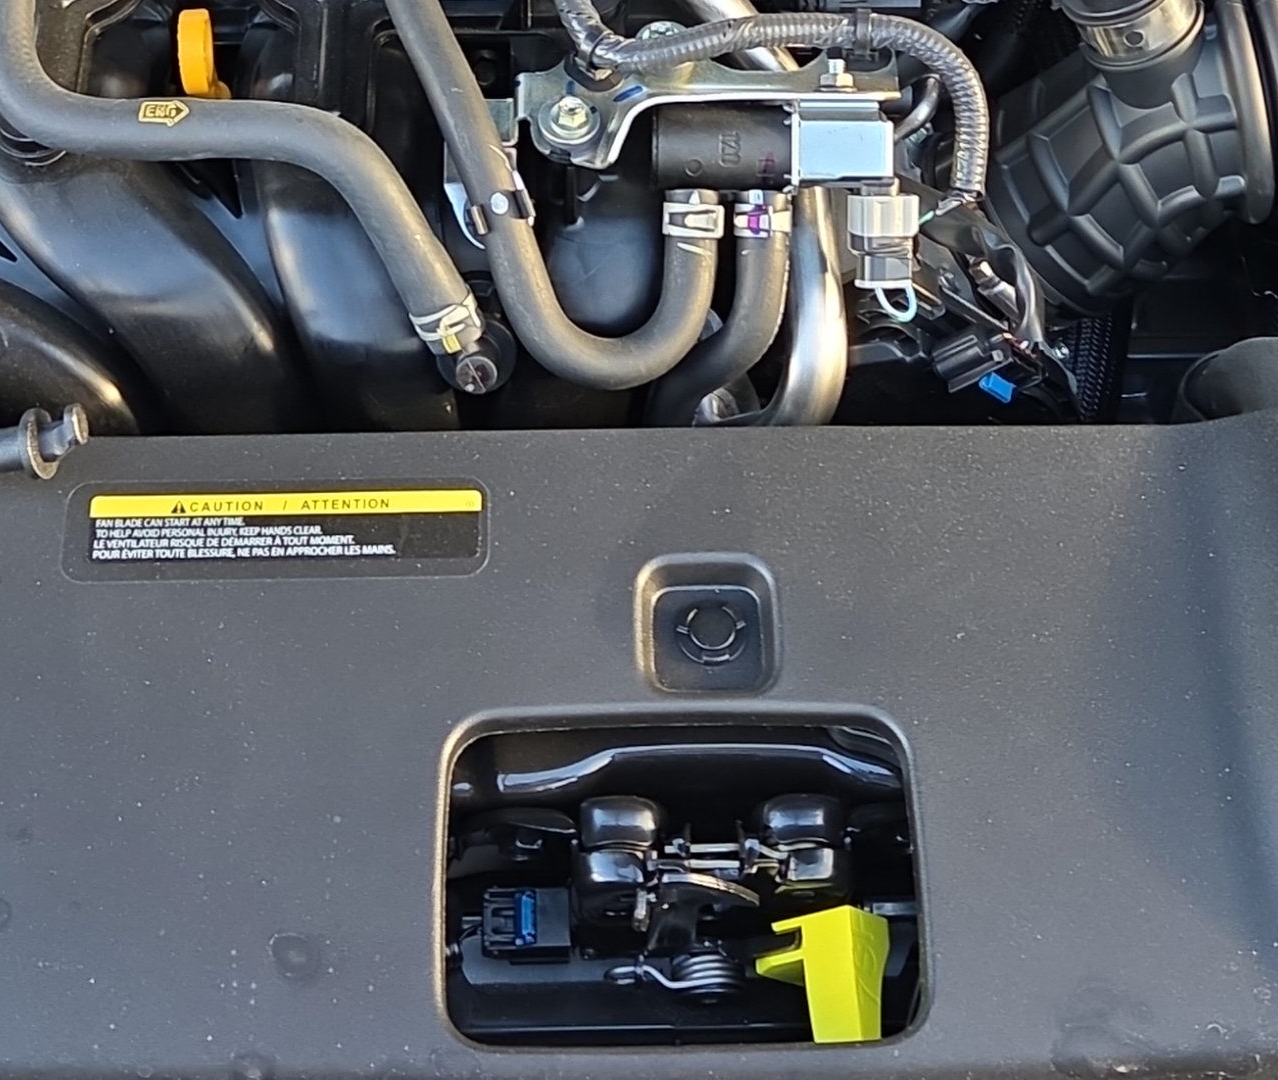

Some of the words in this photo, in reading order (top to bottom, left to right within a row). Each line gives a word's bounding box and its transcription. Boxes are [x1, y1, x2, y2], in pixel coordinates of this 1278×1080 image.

[189, 500, 264, 513] CAUTION
[282, 500, 288, 511] /
[300, 497, 391, 510] ATTENTION
[95, 519, 114, 528] FAN
[114, 518, 143, 528] BLADE
[143, 518, 164, 528] CAN
[164, 518, 190, 527] START
[191, 518, 203, 527] AT
[203, 518, 223, 527] ANY
[222, 517, 246, 526] TIME.
[95, 529, 109, 538] TO
[109, 529, 132, 538] HELP
[132, 528, 160, 538] AVOID
[160, 528, 206, 538] PERSONAL
[238, 527, 261, 537] KEEP
[261, 526, 293, 536] HANDS
[293, 525, 323, 535] CLEAR.
[93, 539, 106, 549] LE
[106, 538, 169, 549] VENTILATEUR
[169, 538, 205, 549] RISQUE
[206, 538, 220, 548] DE
[220, 536, 274, 548] DÉMARRER
[274, 536, 283, 546] À
[282, 536, 309, 546] TOUT
[309, 535, 356, 545] MOMENT.
[92, 549, 121, 560] POUR
[121, 548, 154, 559] ÉVITER
[154, 549, 187, 559] TOUTE
[187, 548, 236, 559] BLESSURE,
[236, 548, 251, 558] NE
[251, 547, 270, 558] PAS
[270, 546, 285, 557] EN
[285, 545, 343, 556] APPROCHER
[343, 545, 362, 555] LES
[361, 544, 397, 555] MAINS.
